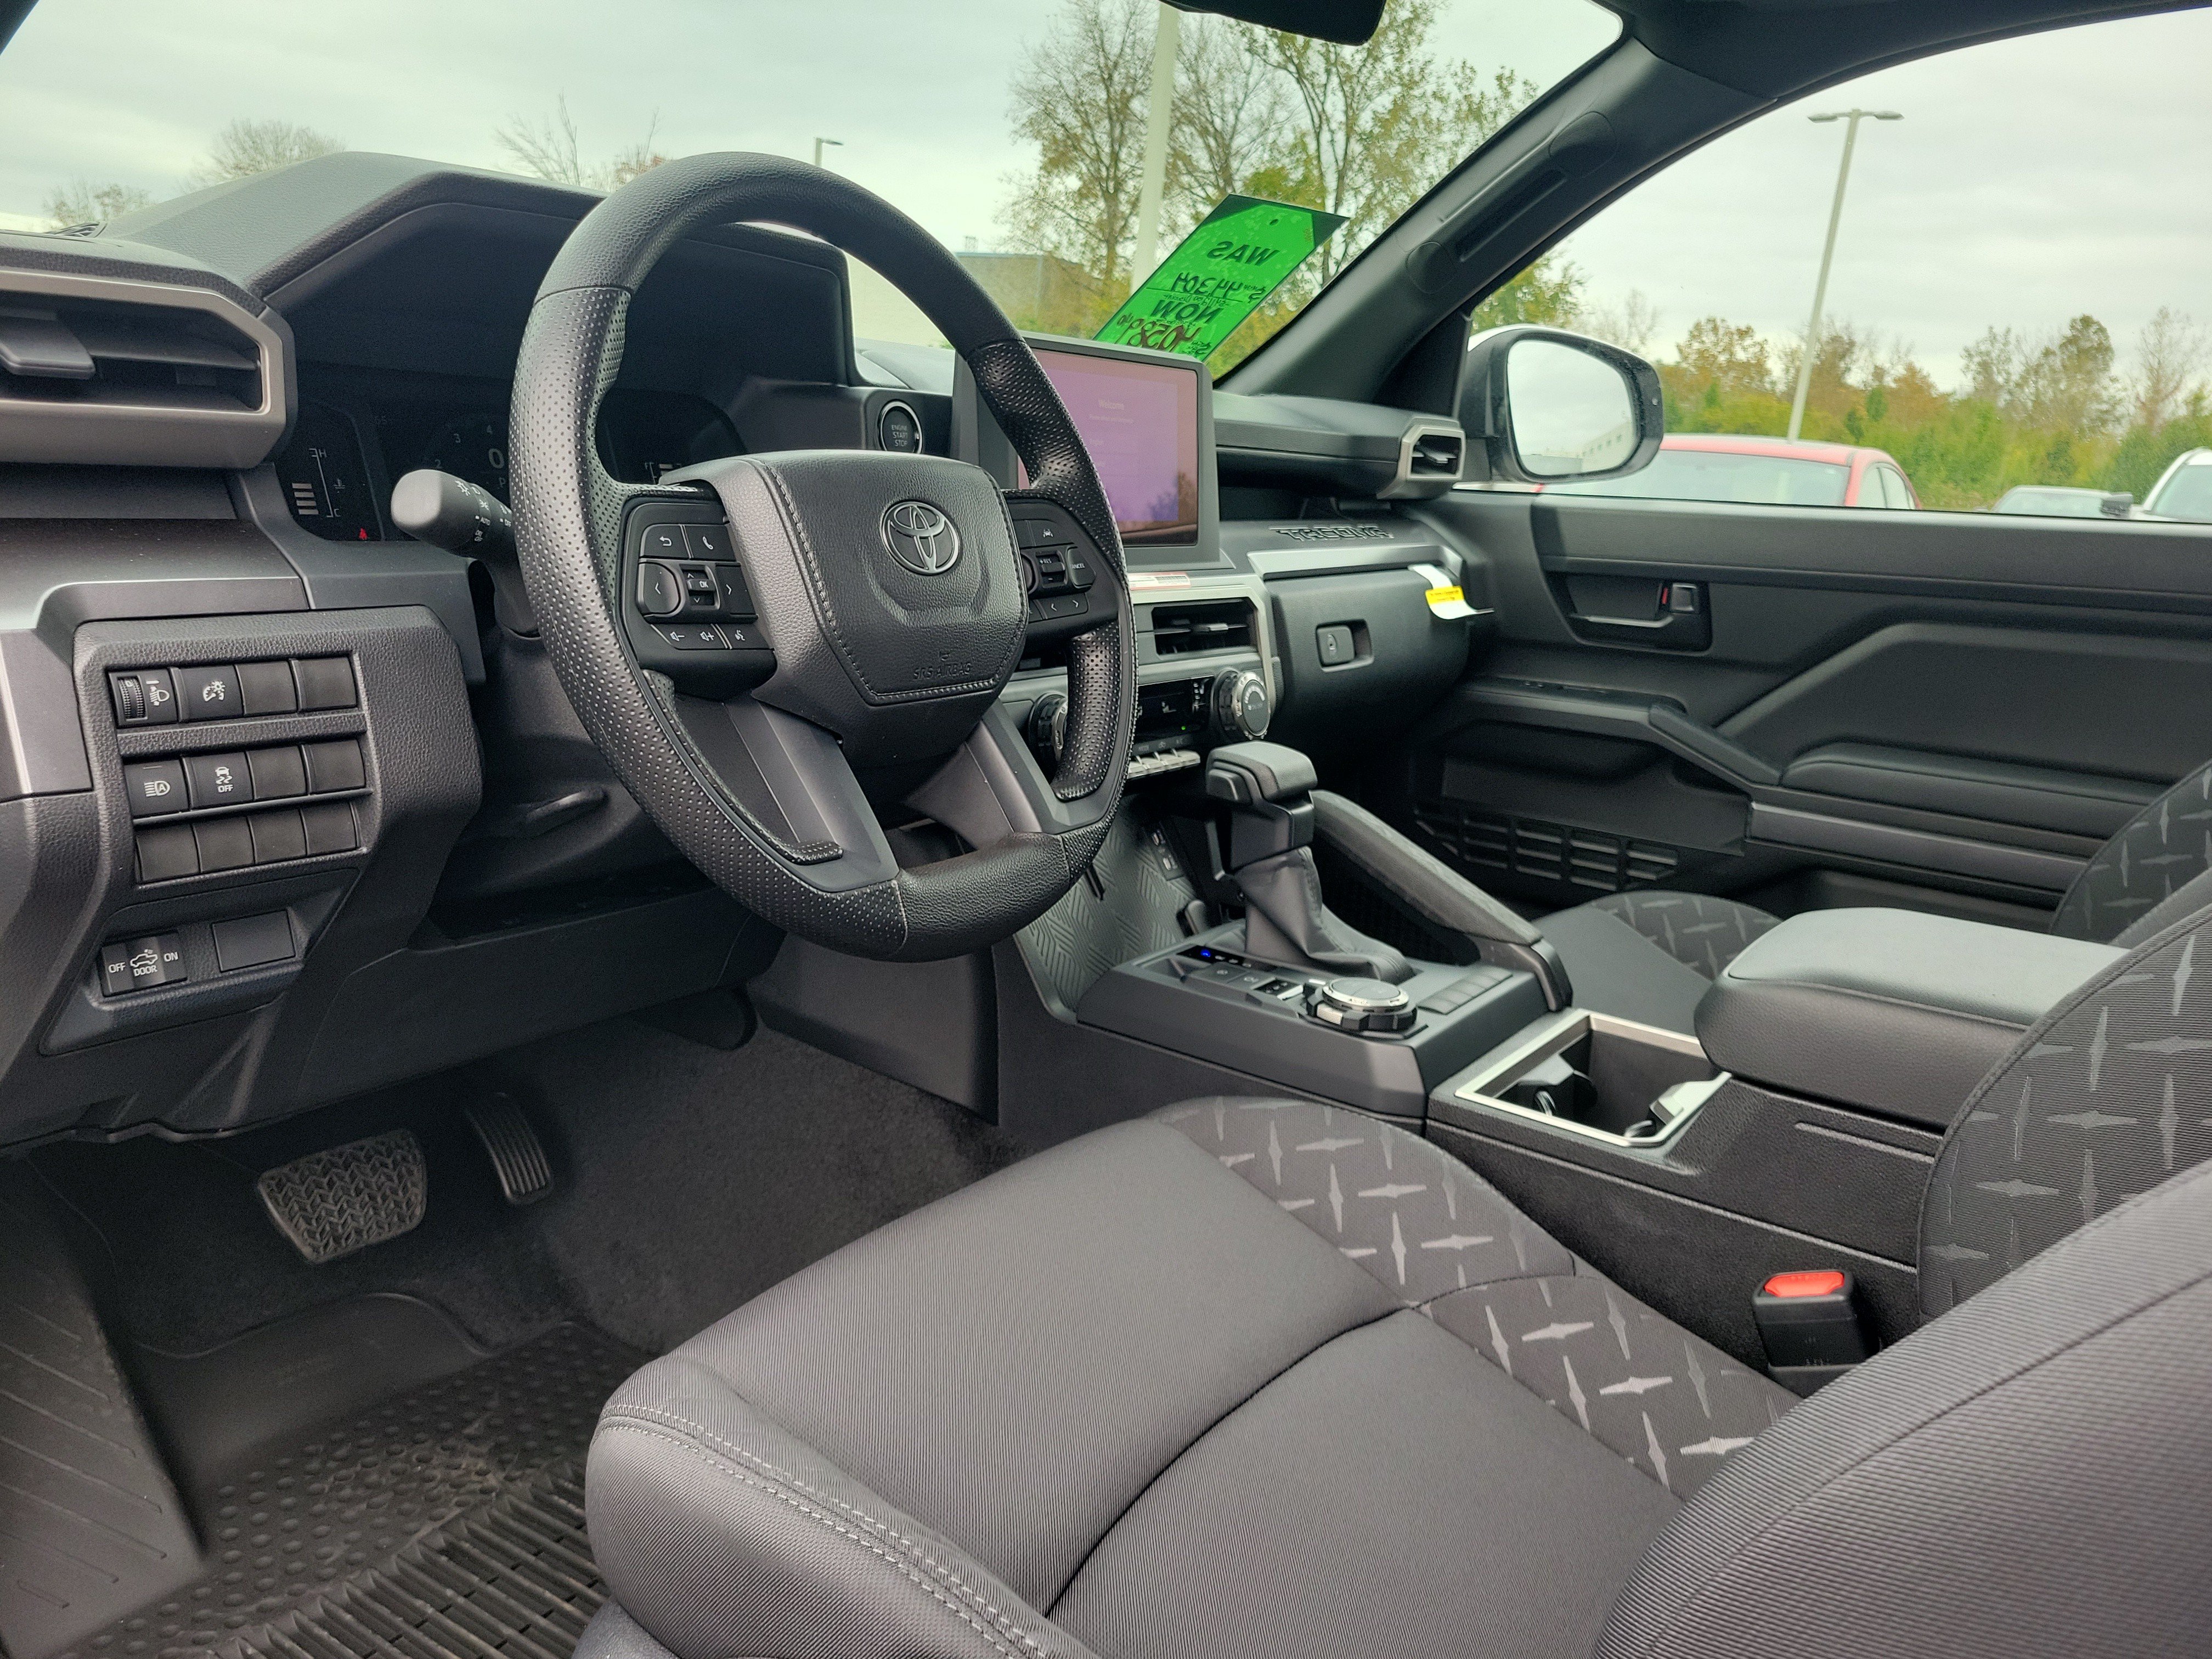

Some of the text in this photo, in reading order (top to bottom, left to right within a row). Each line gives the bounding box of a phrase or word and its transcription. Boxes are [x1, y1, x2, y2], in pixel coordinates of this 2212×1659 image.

[454, 433, 461, 443] 3
[319, 449, 327, 458] H
[488, 448, 505, 469] 0
[499, 477, 506, 488] P
[217, 784, 233, 793] OFF
[164, 951, 178, 962] ON
[109, 962, 126, 973] OFF
[133, 965, 157, 977] DOOR
